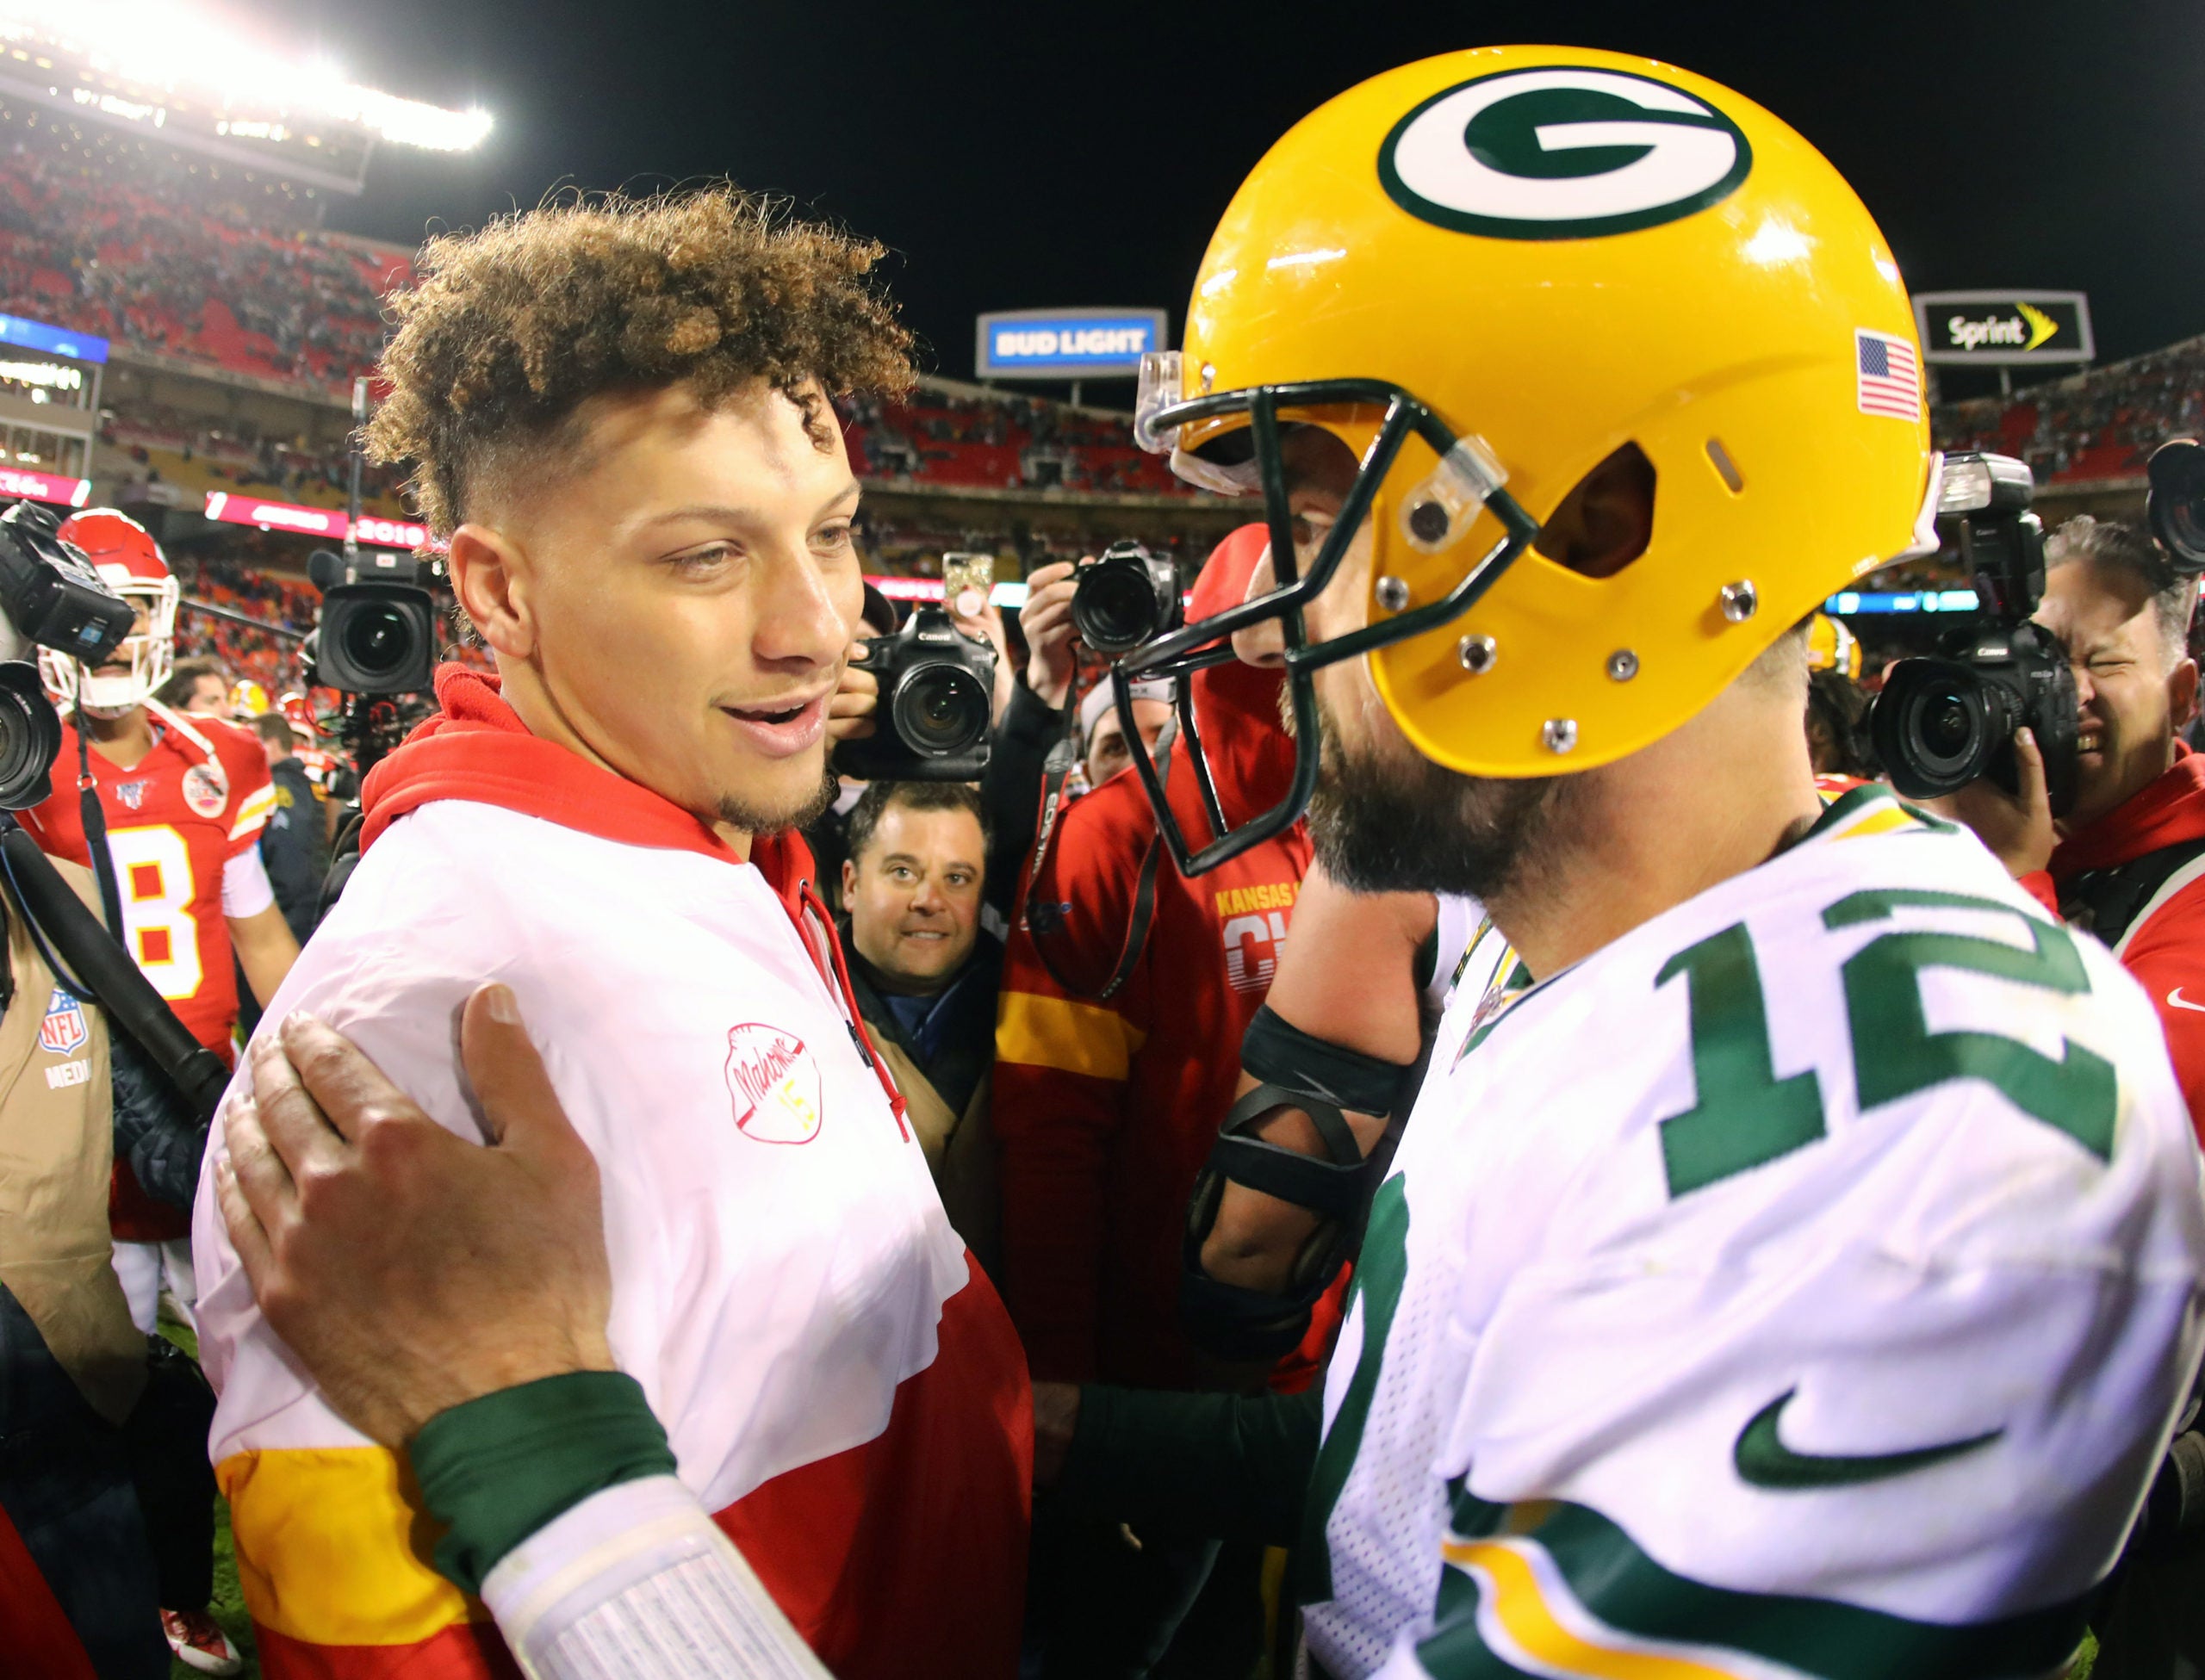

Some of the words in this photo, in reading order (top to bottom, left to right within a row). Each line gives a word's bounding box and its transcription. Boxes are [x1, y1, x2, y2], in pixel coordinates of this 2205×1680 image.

[1392, 68, 1738, 222] G
[997, 331, 1059, 356] BUD
[1059, 328, 1147, 355] LIGHT
[1948, 315, 2025, 350] Sprint
[917, 631, 952, 642] Canon
[105, 823, 204, 1001] 8
[1214, 882, 1293, 918] KANSAS
[42, 1013, 82, 1045] NFL
[1655, 888, 2119, 1200] 12
